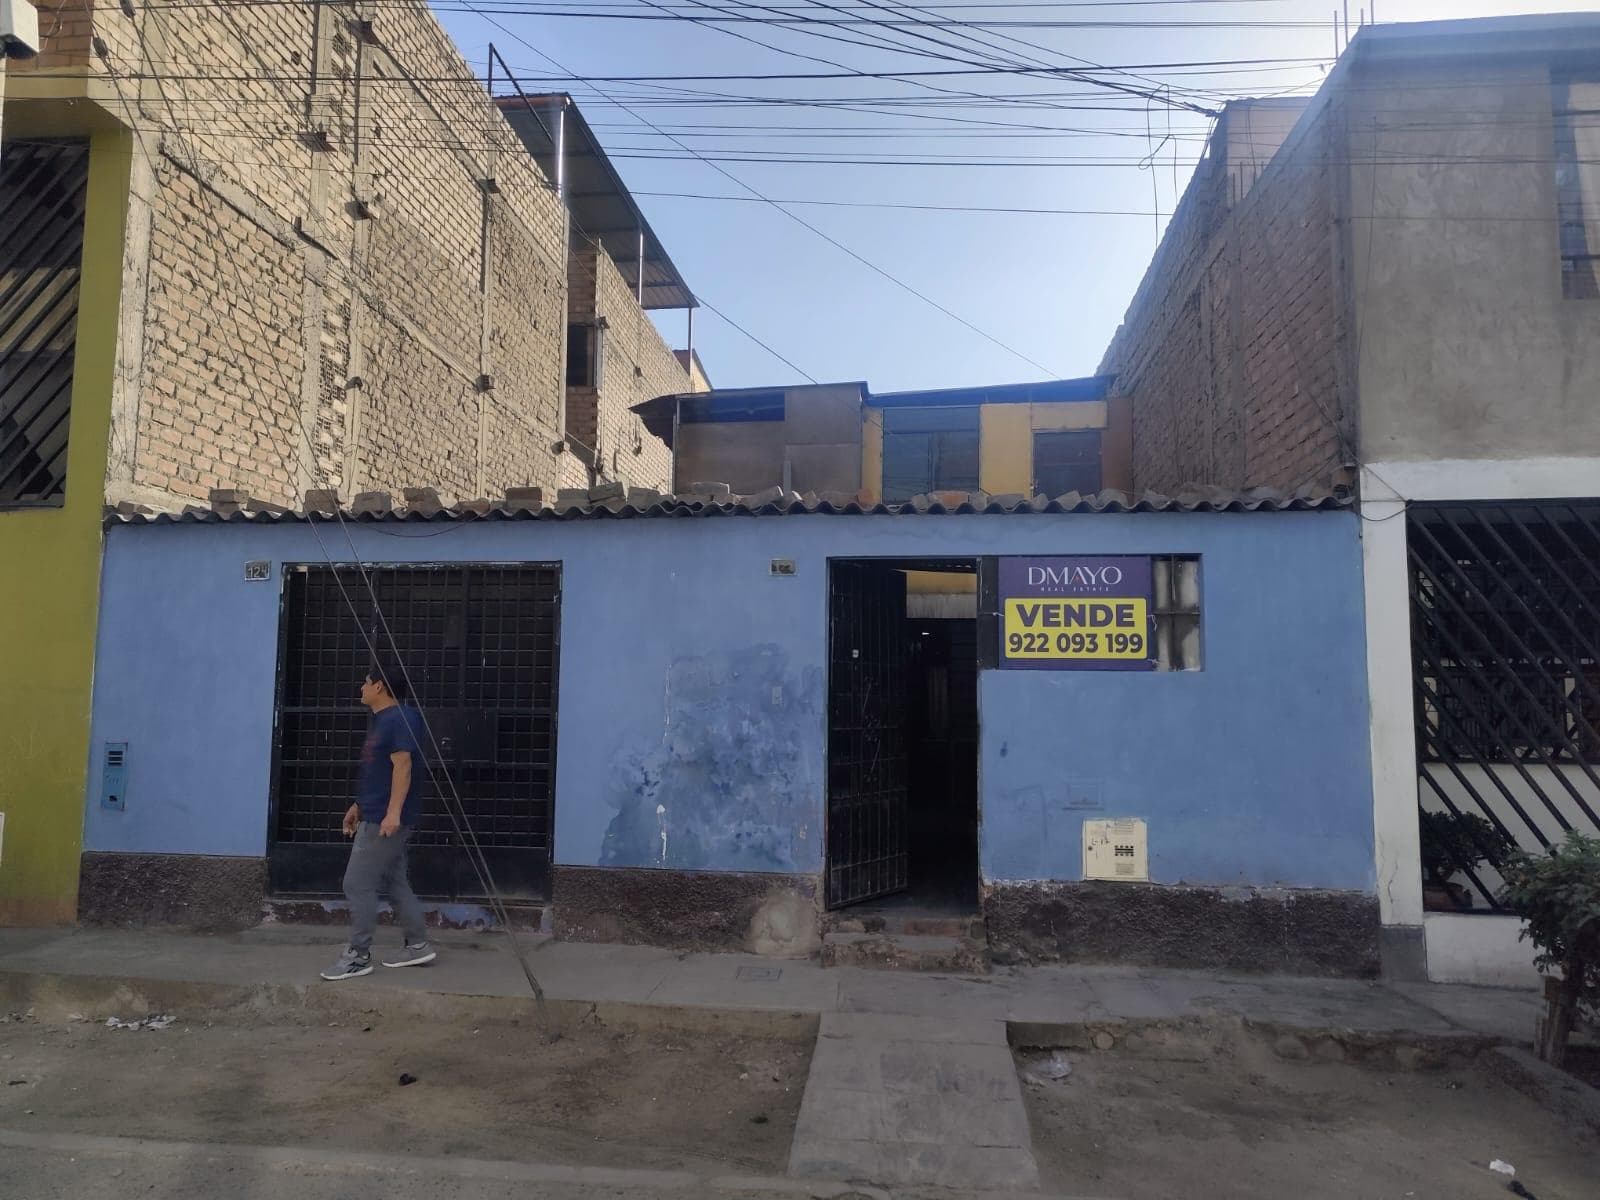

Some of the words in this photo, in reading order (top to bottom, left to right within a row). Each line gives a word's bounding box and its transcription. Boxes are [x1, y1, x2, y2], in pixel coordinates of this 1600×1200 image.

[1028, 566, 1122, 585] DMAYO
[1016, 604, 1135, 627] VENDE
[1009, 633, 1049, 653] 922
[1056, 633, 1099, 653] 093
[1105, 633, 1143, 653] 199
